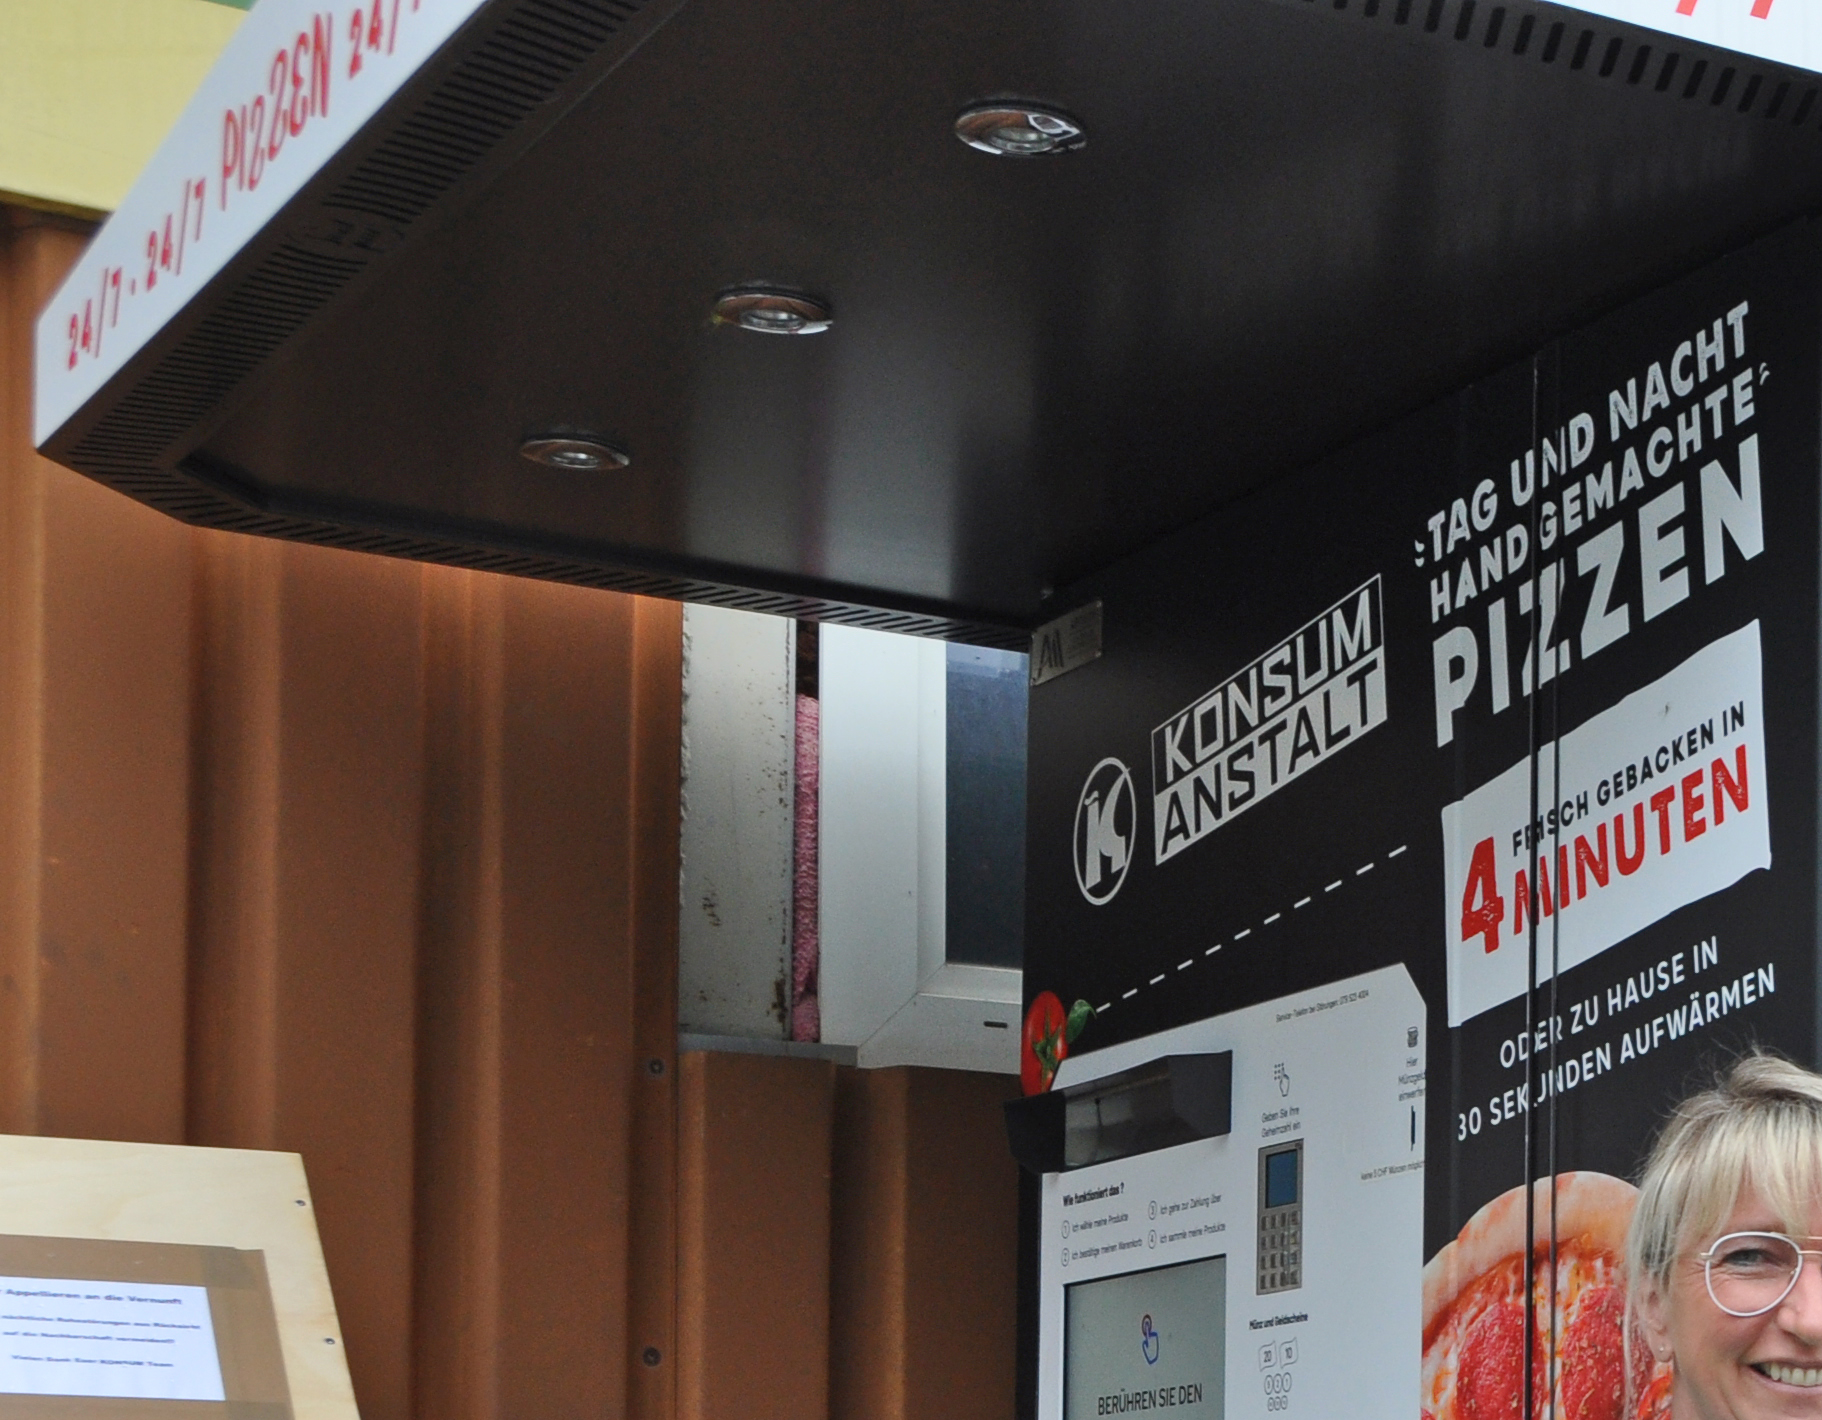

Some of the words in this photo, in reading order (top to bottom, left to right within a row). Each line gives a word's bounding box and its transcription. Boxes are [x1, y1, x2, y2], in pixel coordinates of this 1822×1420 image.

[68, 267, 122, 371] 24/7
[146, 178, 208, 291] 24/7
[1427, 477, 1498, 562] TAG
[1510, 412, 1595, 507] UND
[1608, 300, 1749, 442] NACHT
[1429, 366, 1756, 624] HANDGEMACHTE
[1432, 432, 1765, 748] PIZZEN
[1160, 655, 1379, 857] ANSTALT
[1164, 588, 1372, 784] KONSUM
[1596, 717, 1715, 807] GEBACKEN
[1722, 700, 1746, 738] IN
[1460, 836, 1504, 954] 4
[1512, 743, 1750, 936] MINUTEN
[1458, 1106, 1482, 1141] 30
[1619, 962, 1776, 1065] AUFWÄRMEN
[1500, 1015, 1563, 1069] ODER
[1570, 1000, 1600, 1035] ZU
[1607, 951, 1685, 1017] HAUSE
[1693, 936, 1719, 974] IN
[1062, 1194, 1074, 1207] Wie
[1074, 1187, 1109, 1206] funktioniert
[1109, 1185, 1120, 1198] das
[1261, 1111, 1279, 1124] Geben
[1279, 1108, 1288, 1119] Sie
[1261, 1122, 1292, 1138] Geheimzahl
[1097, 1388, 1157, 1416] BERÜHREN
[1158, 1386, 1176, 1408] SIE
[1178, 1383, 1203, 1405] DEN
